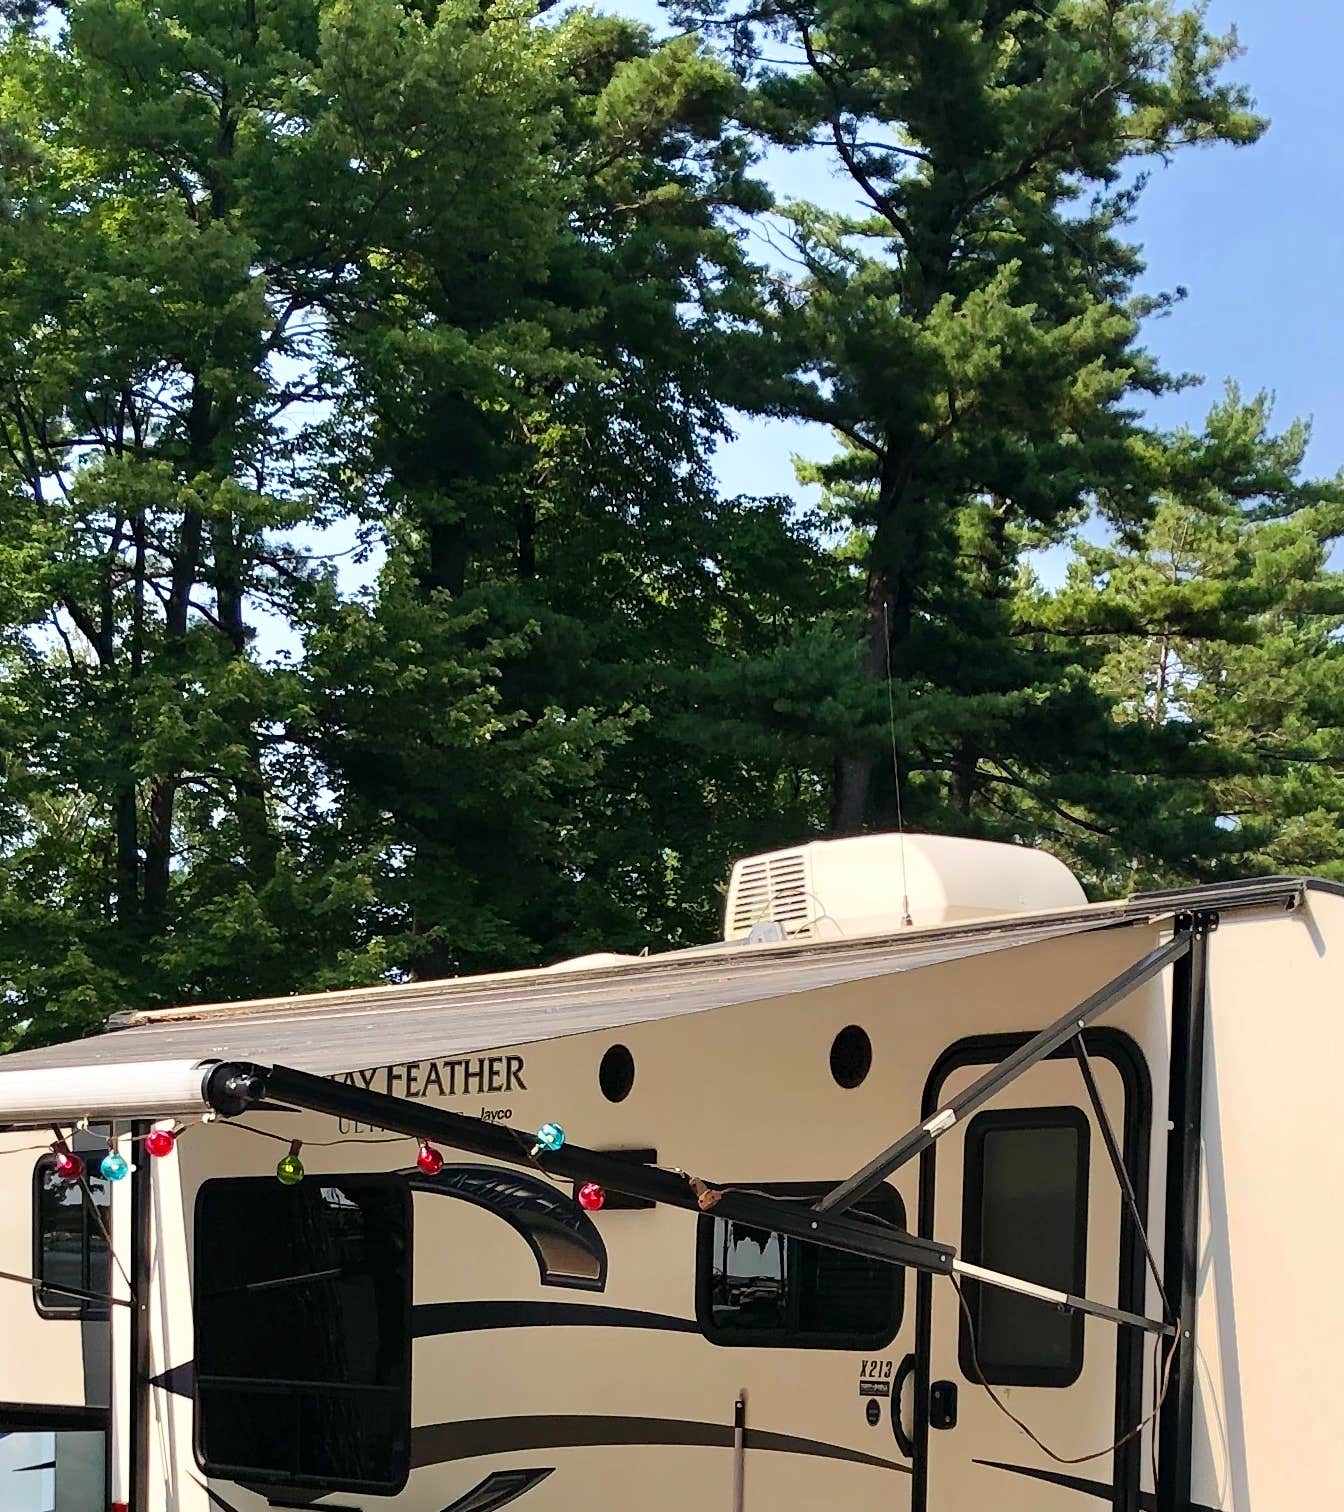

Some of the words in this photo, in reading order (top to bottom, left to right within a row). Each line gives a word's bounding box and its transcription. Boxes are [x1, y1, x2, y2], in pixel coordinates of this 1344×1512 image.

[386, 1054, 528, 1099] FEATHER
[480, 1106, 513, 1124] Jayco
[859, 1359, 893, 1378] X213
